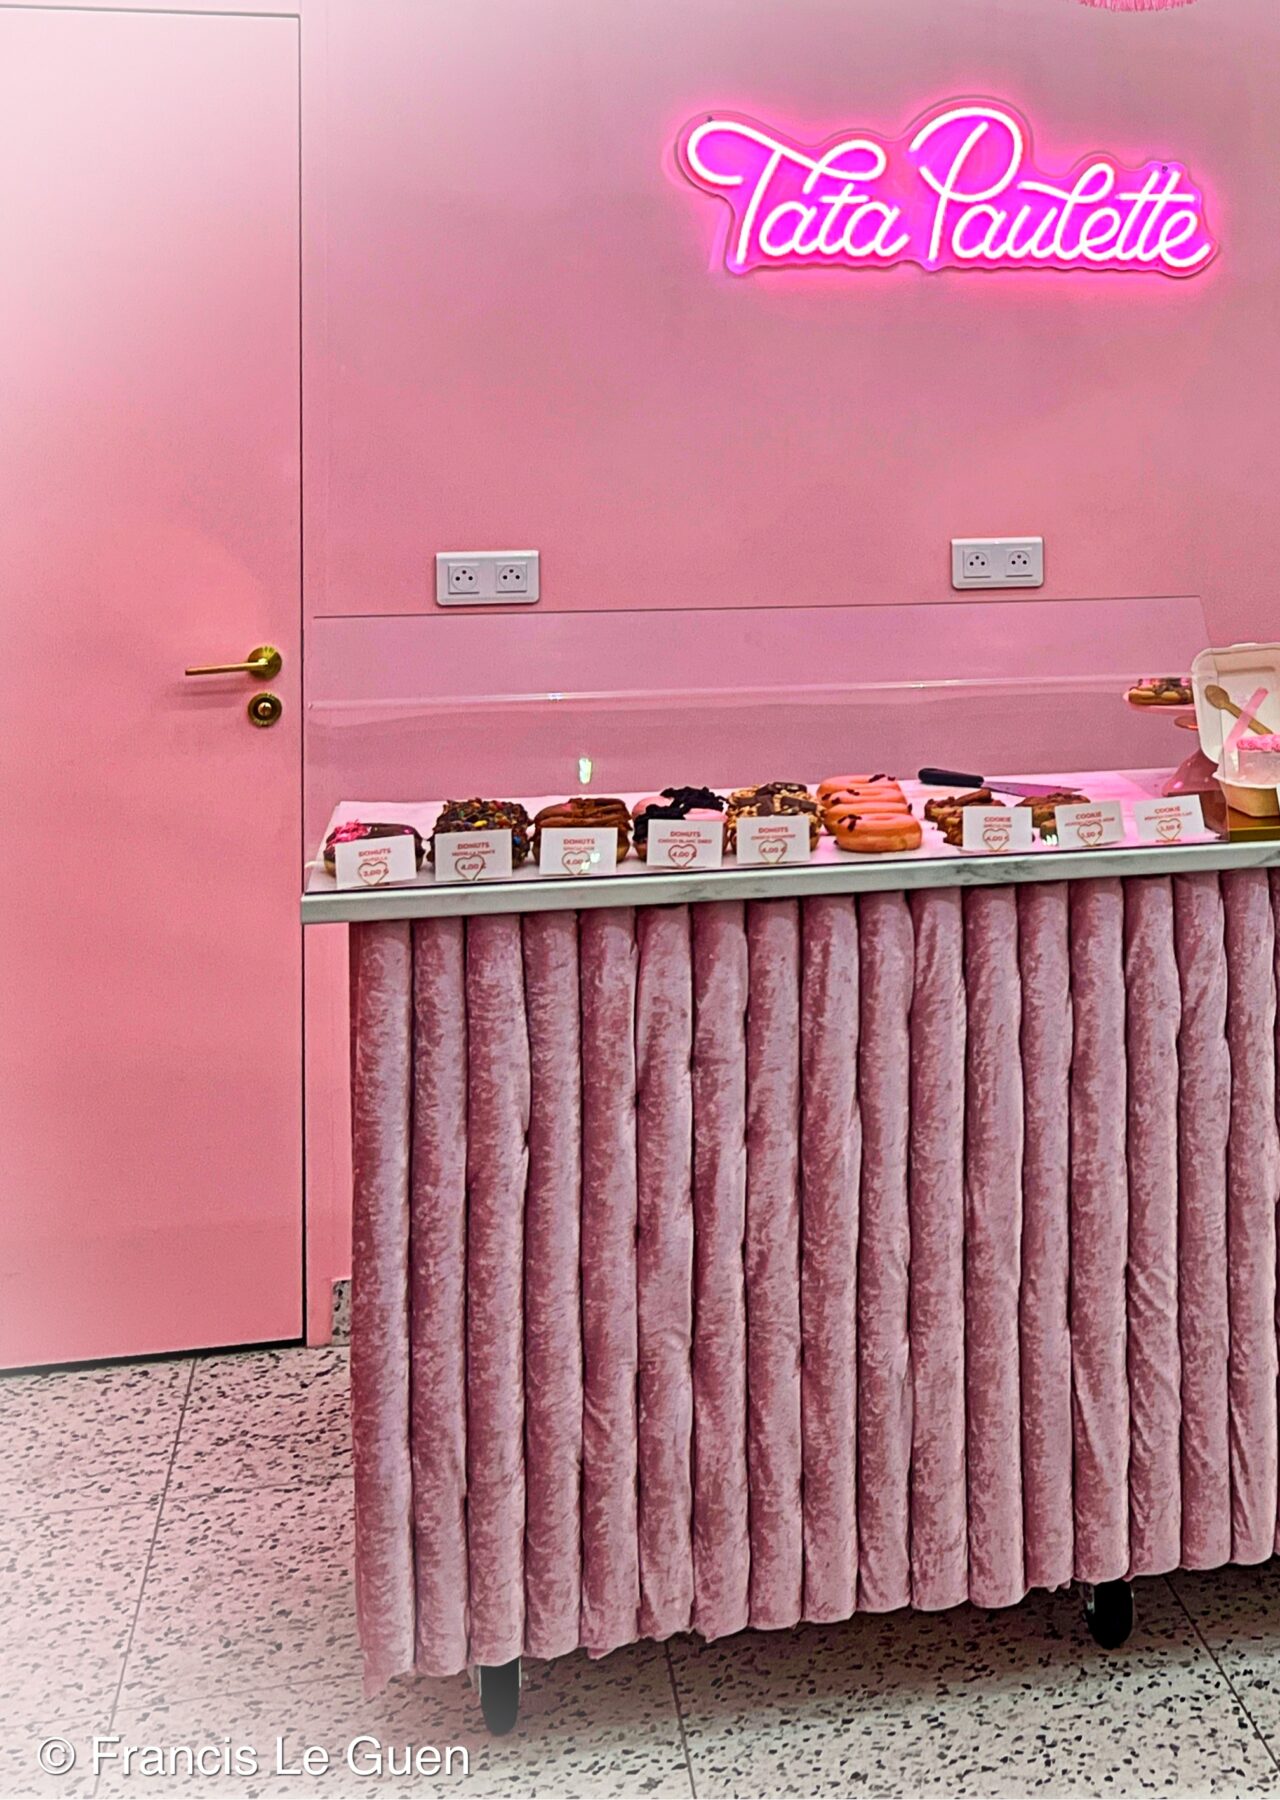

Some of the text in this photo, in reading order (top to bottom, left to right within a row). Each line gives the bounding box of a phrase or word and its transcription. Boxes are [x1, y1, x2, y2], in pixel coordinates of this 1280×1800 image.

[686, 106, 1212, 267] Tata Paulette
[1154, 806, 1181, 814] COOKIE
[1075, 811, 1102, 820] COOKIE
[457, 841, 490, 850] DONUTS
[358, 847, 392, 857] DONUTS
